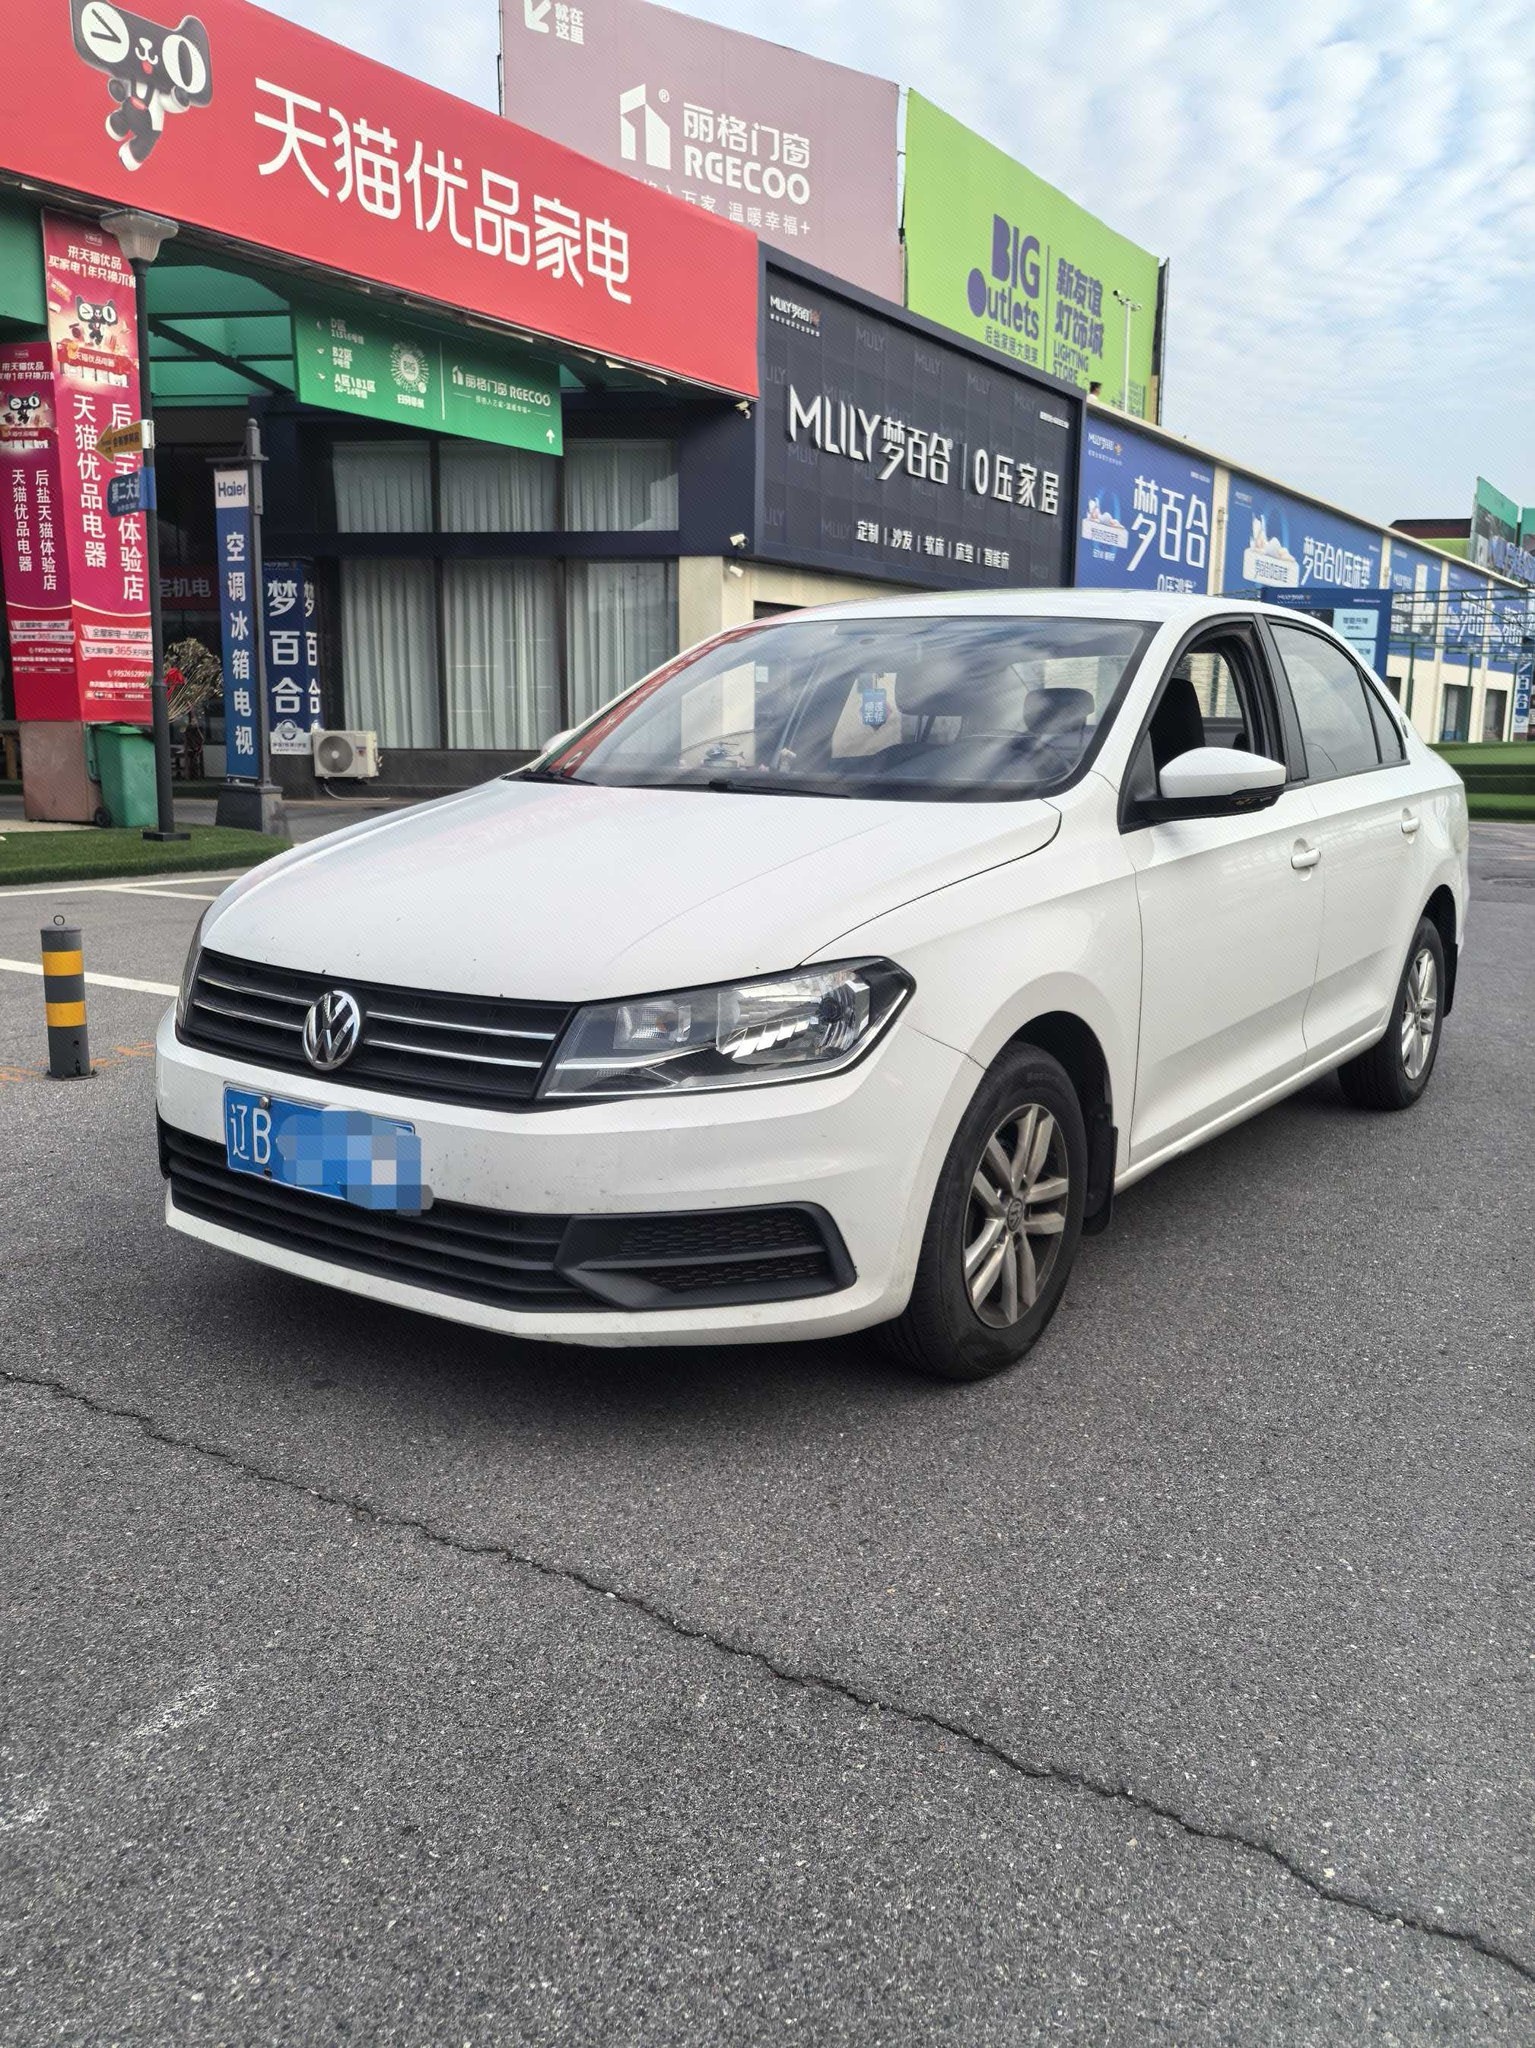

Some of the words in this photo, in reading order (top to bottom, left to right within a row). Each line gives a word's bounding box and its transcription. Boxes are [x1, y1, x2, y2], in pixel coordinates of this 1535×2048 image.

[683, 102, 810, 169] 丽格门窗
[254, 77, 632, 304] 天猫优品家电
[967, 267, 1039, 341] Outlets
[991, 213, 1040, 300] BIG
[465, 373, 508, 396] 丽格门窗
[1053, 340, 1089, 373] LIGHTING
[73, 394, 107, 568] 天猫优品电器
[217, 480, 247, 497] Haier
[789, 384, 881, 462] MLILY
[878, 417, 951, 484] 梦百合
[974, 448, 1060, 516] 0压家居
[12, 469, 32, 572] 天猫优品电器
[35, 469, 57, 591] 后盐天猫体验店
[856, 520, 879, 544] 定制
[890, 527, 913, 551] 沙发
[1127, 475, 1208, 572] 梦百合
[226, 531, 254, 756] 空调冰箱电视
[267, 579, 303, 714] 梦百合
